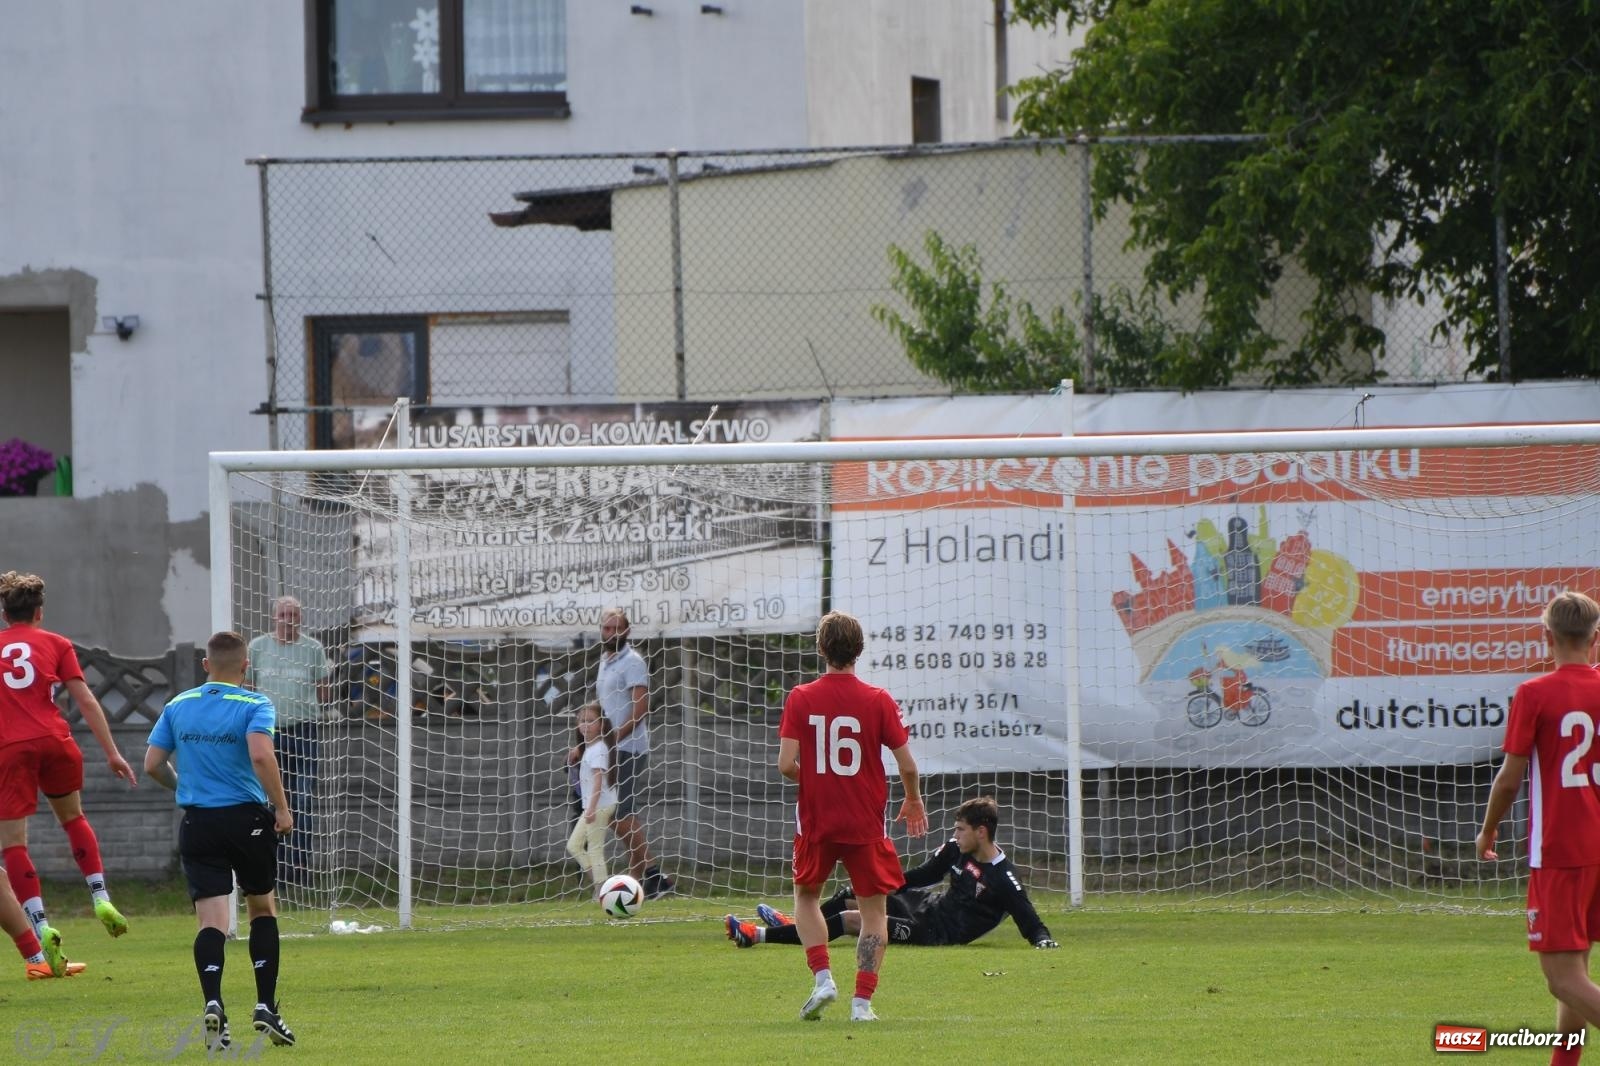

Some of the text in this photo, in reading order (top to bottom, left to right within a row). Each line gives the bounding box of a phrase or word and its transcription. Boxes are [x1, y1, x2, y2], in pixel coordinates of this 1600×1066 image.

[565, 513, 713, 544] Zawadzki
[868, 537, 887, 566] z
[529, 571, 579, 593] 504
[591, 569, 635, 592] 165
[641, 567, 690, 592] 816
[383, 604, 470, 629] 4-451
[479, 601, 599, 628] Tworków
[657, 601, 670, 624] 1
[681, 598, 746, 627] Maja
[754, 597, 785, 620] 10
[869, 623, 1047, 642] +48 32 740 91 93
[871, 651, 1047, 670] +48 608 00 38 28
[1387, 638, 1549, 662] tłumaczeni
[1, 642, 35, 689] 3
[895, 693, 1019, 716] zymały 36/1
[908, 720, 1043, 739] 400 Racibórz
[808, 714, 862, 777] 16
[1560, 711, 1600, 788] 2
